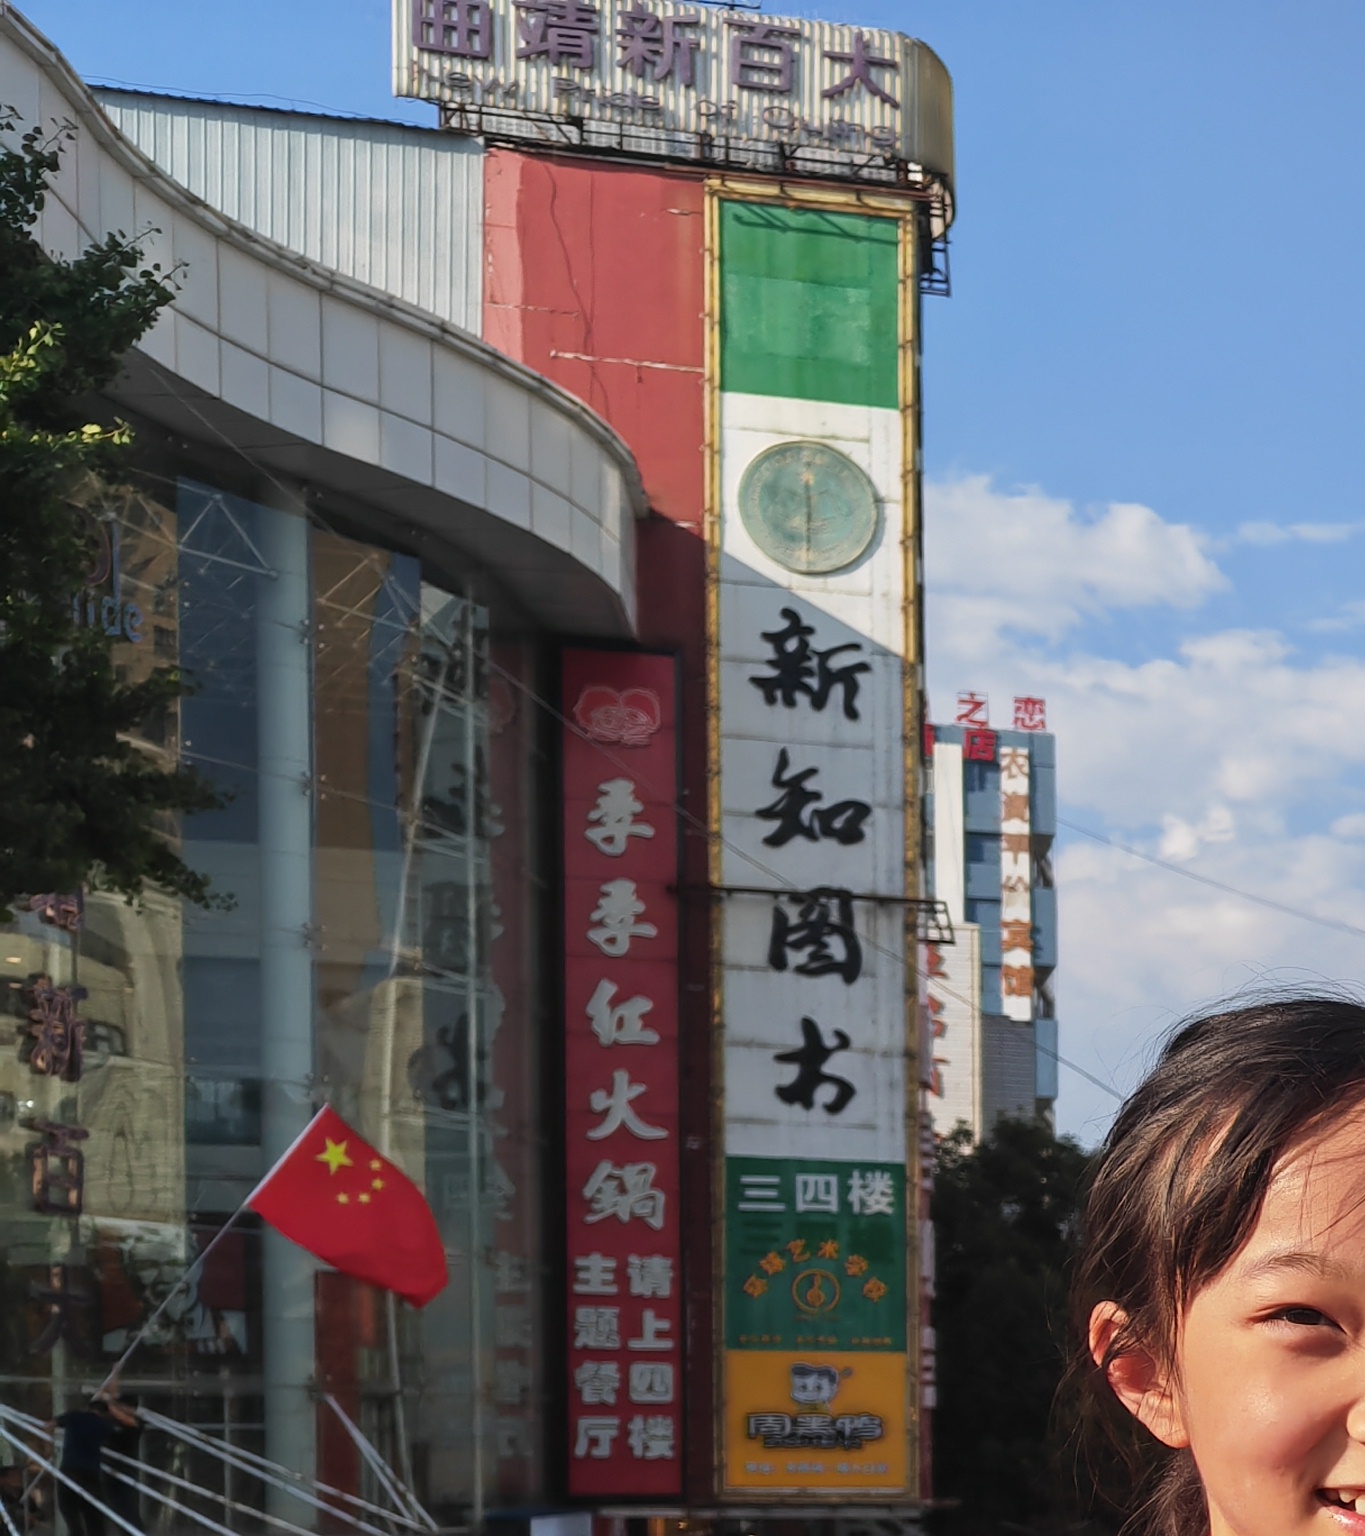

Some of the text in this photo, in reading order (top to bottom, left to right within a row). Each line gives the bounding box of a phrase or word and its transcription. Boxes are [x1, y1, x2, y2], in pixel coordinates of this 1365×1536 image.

[412, 0, 900, 109] 曲靖新百大
[748, 606, 873, 1116] 新知图书
[737, 1169, 895, 1216] 三四楼
[573, 1252, 621, 1461] 主题餐厅
[627, 1252, 675, 1461] 请上四楼
